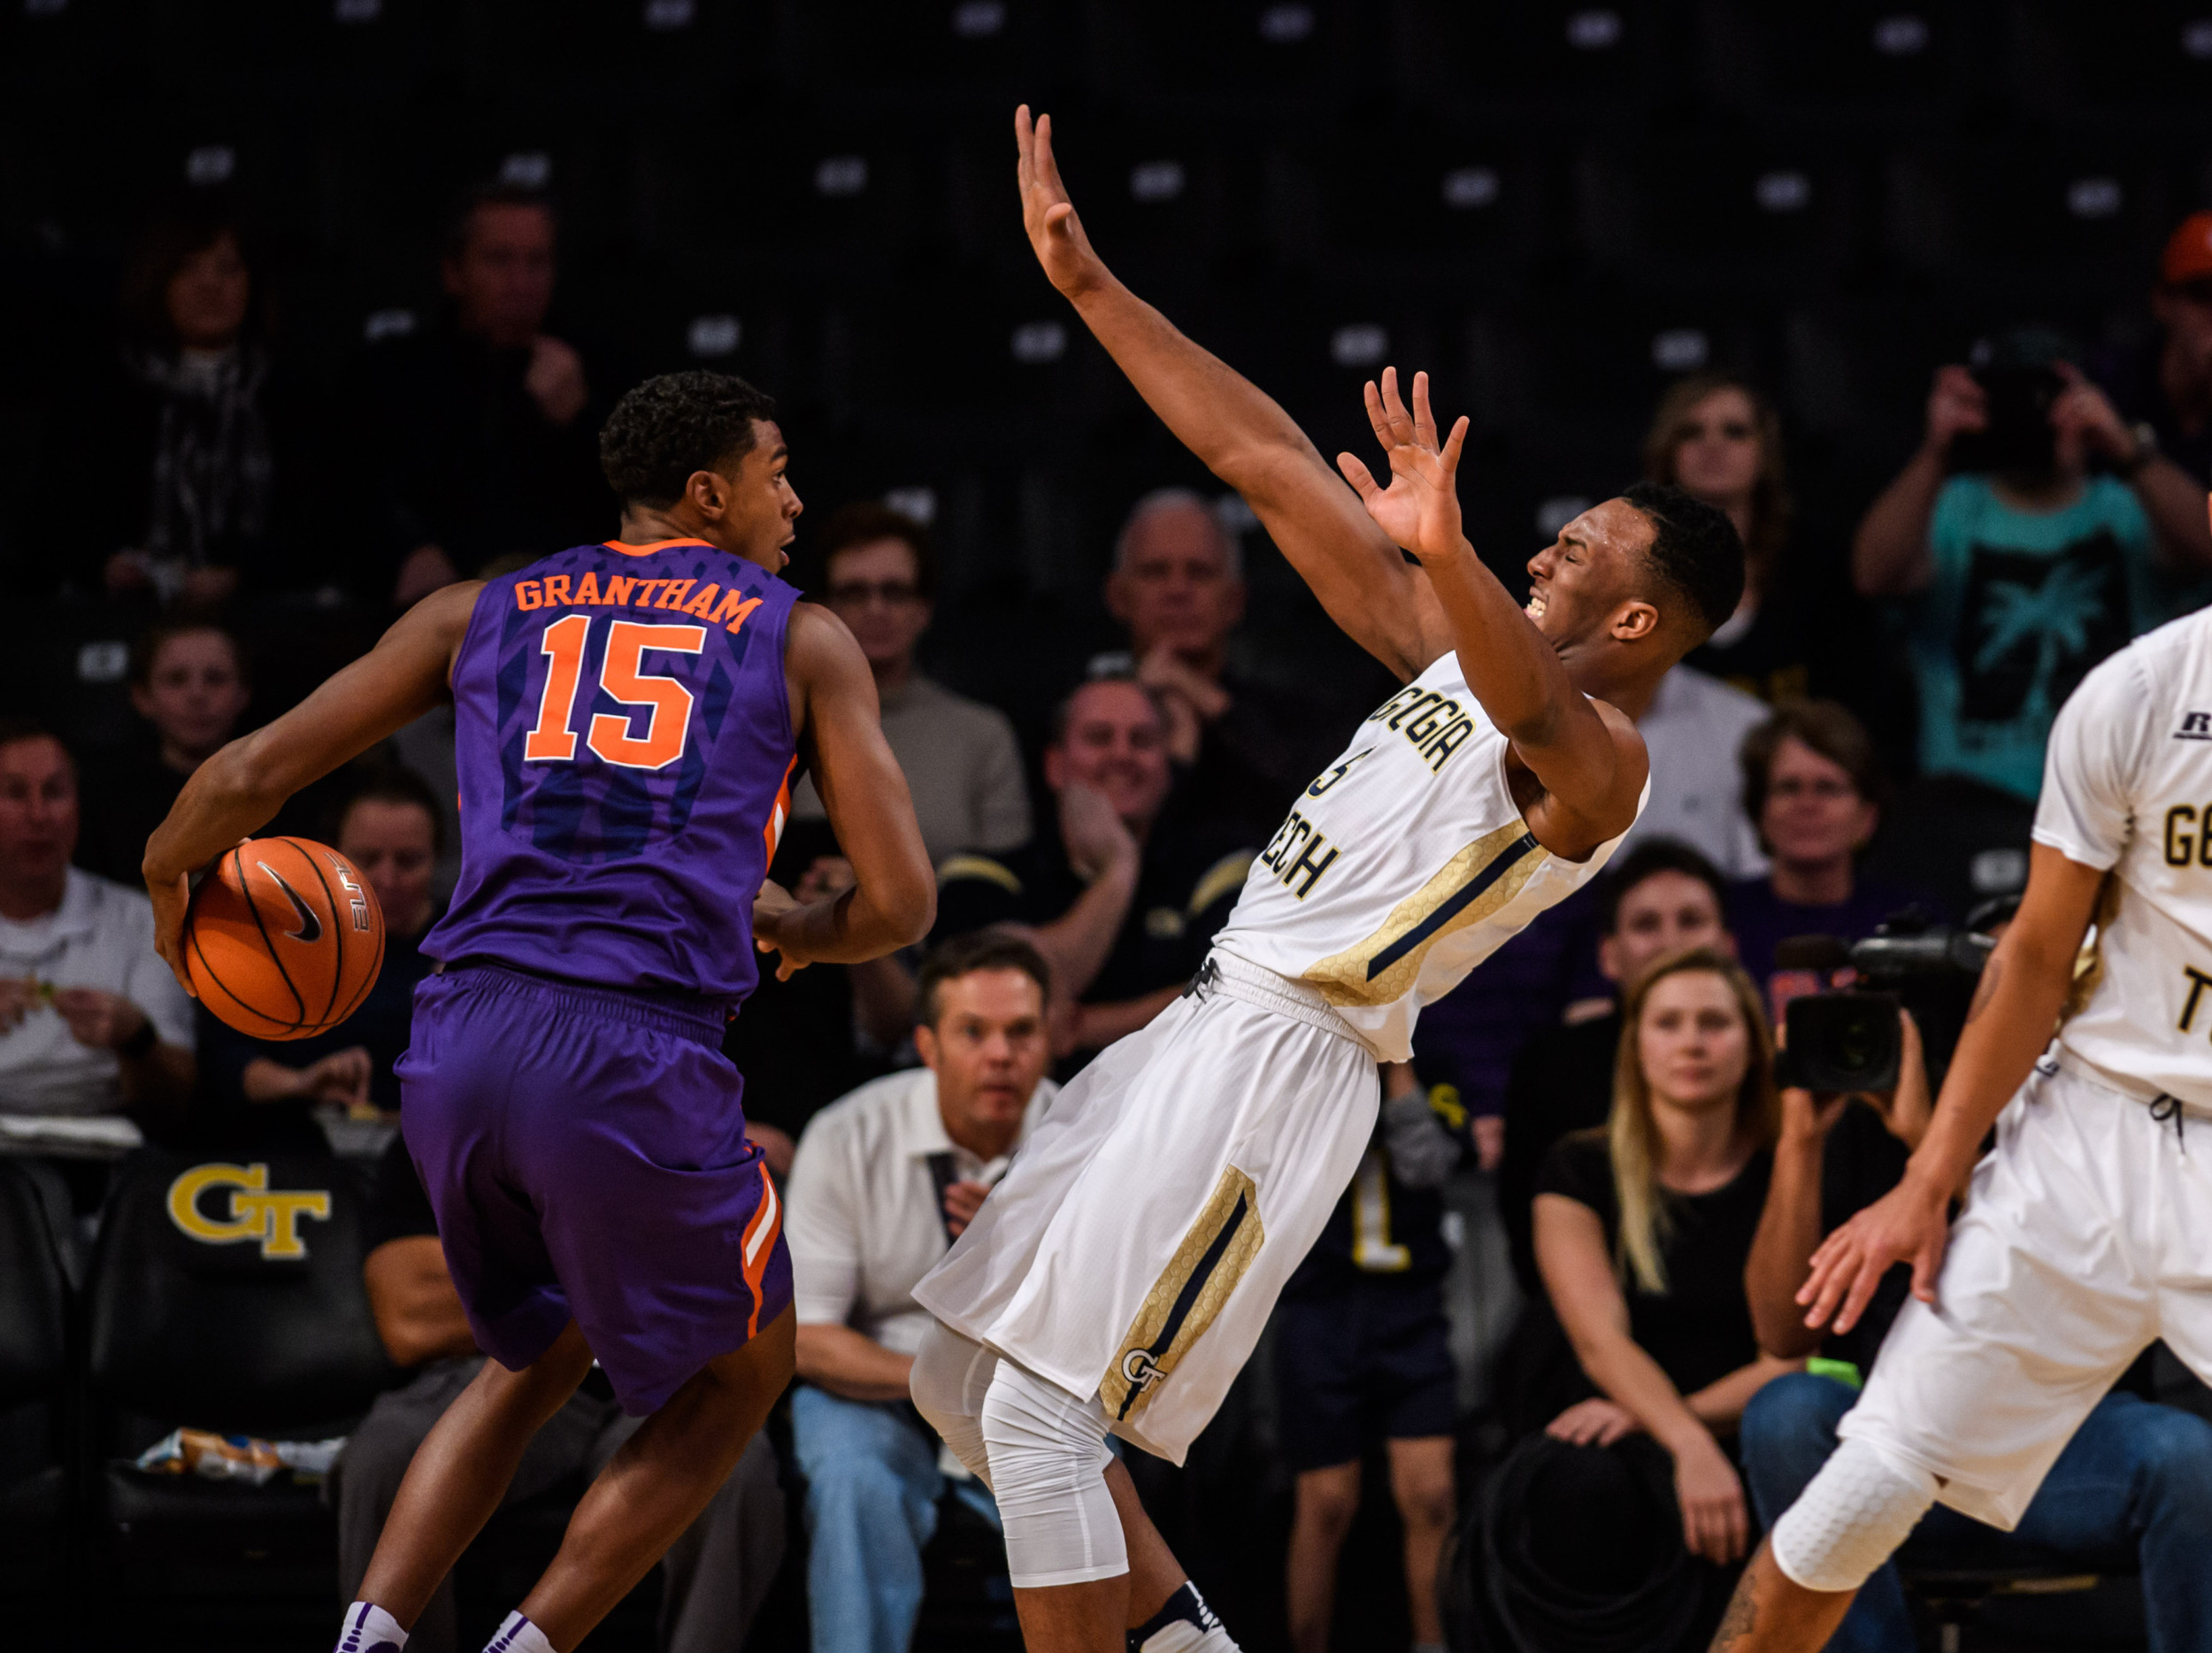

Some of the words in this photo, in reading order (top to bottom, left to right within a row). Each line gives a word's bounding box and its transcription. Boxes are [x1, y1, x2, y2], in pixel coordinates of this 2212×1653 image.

[514, 572, 764, 634] GRANTHAM
[524, 614, 707, 770] 15
[1260, 811, 1341, 901] ECH
[168, 1164, 332, 1260] GT
[1122, 1348, 1168, 1393] GT
